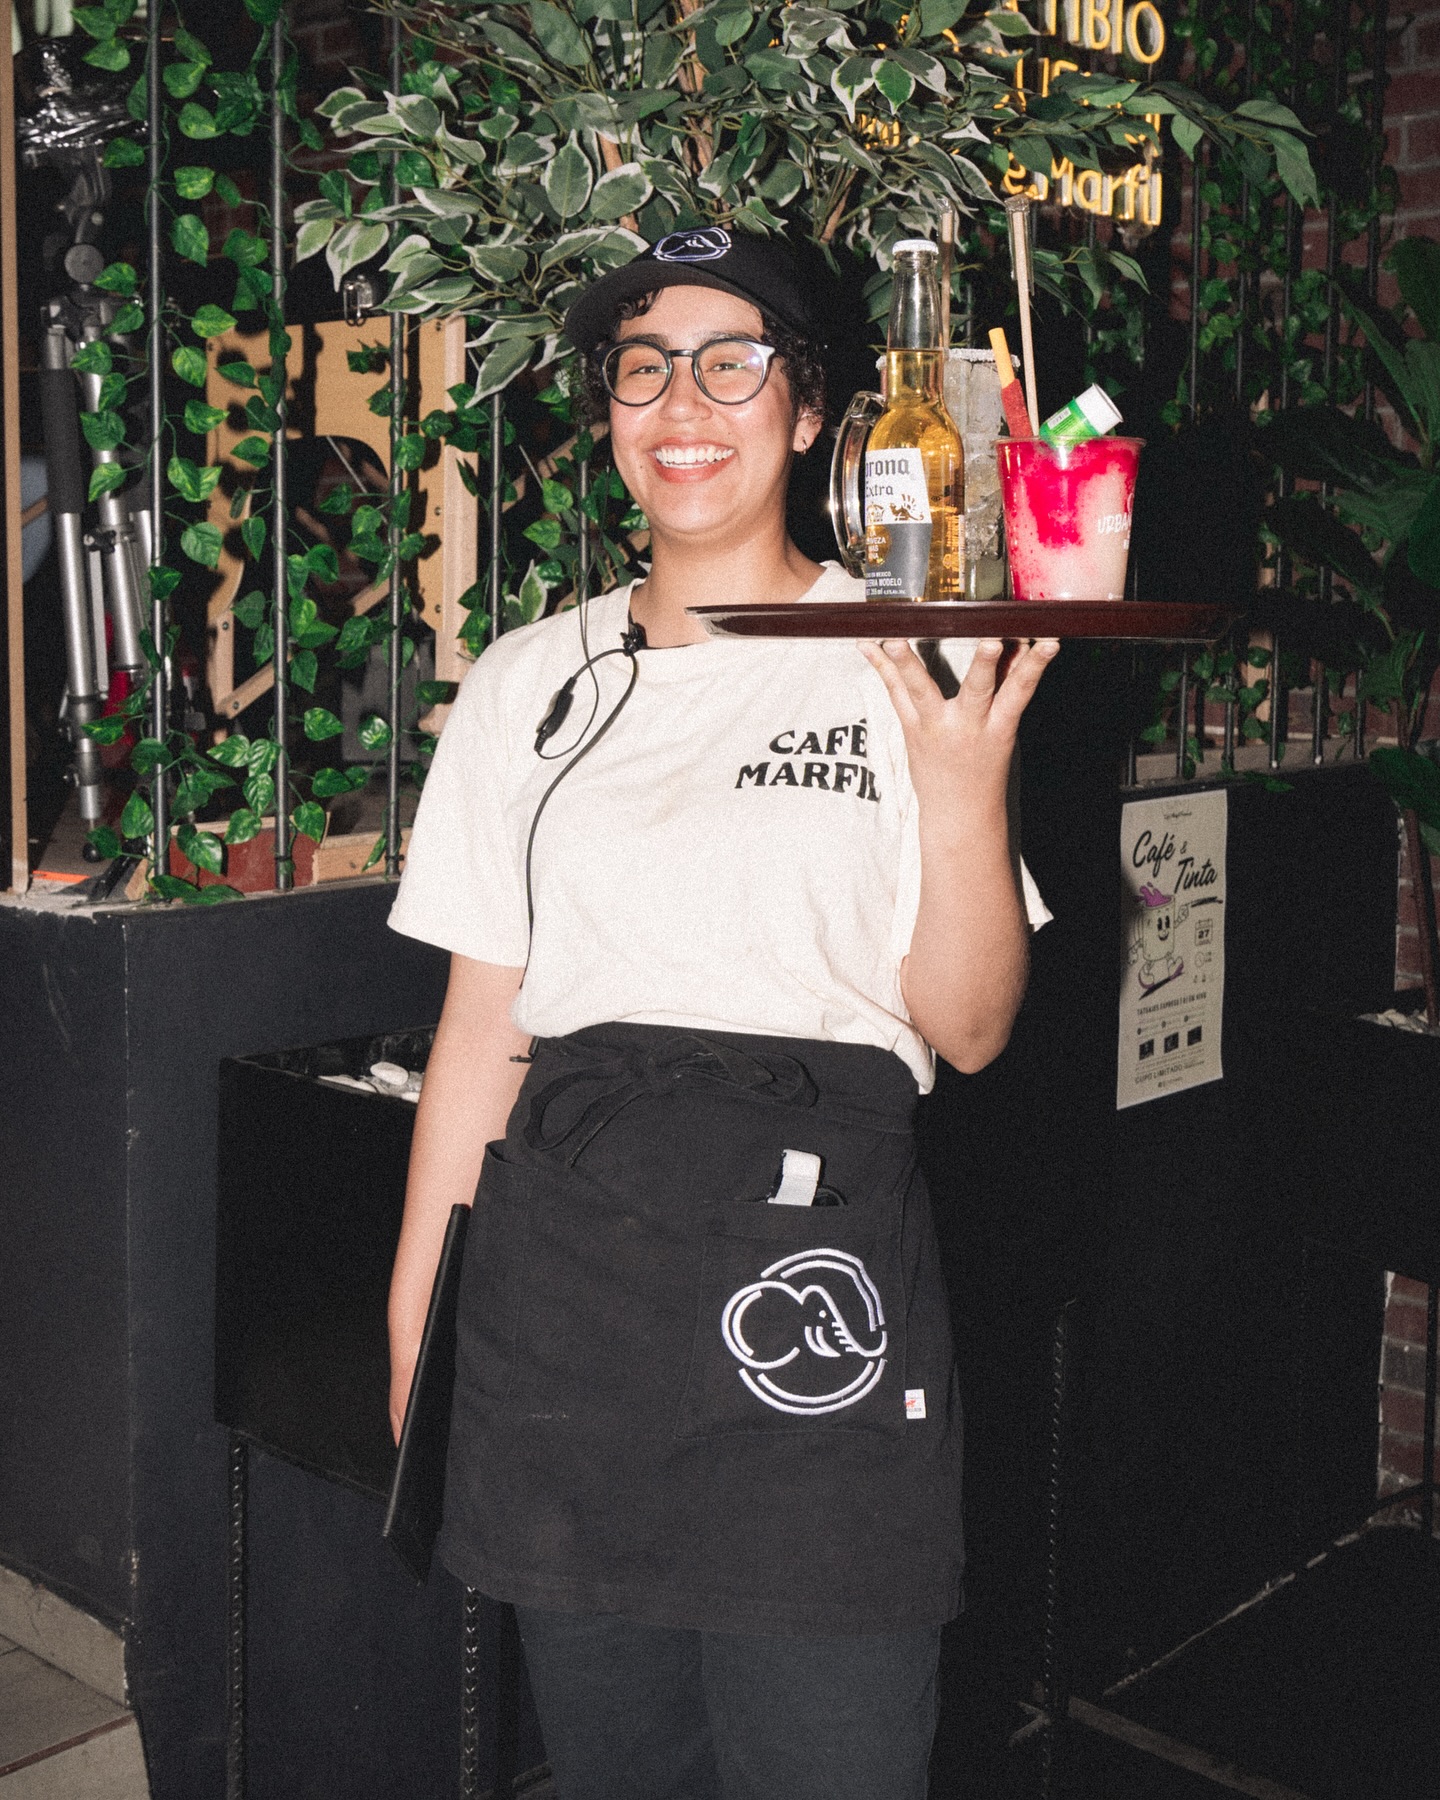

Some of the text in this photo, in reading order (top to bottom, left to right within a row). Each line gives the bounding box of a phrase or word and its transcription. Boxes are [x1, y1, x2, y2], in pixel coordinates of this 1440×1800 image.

[879, 578, 902, 587] MODELO
[769, 718, 867, 758] CAFÉ
[734, 761, 882, 803] MARFIL
[1133, 830, 1176, 878] Café
[1174, 856, 1218, 894] Tinta
